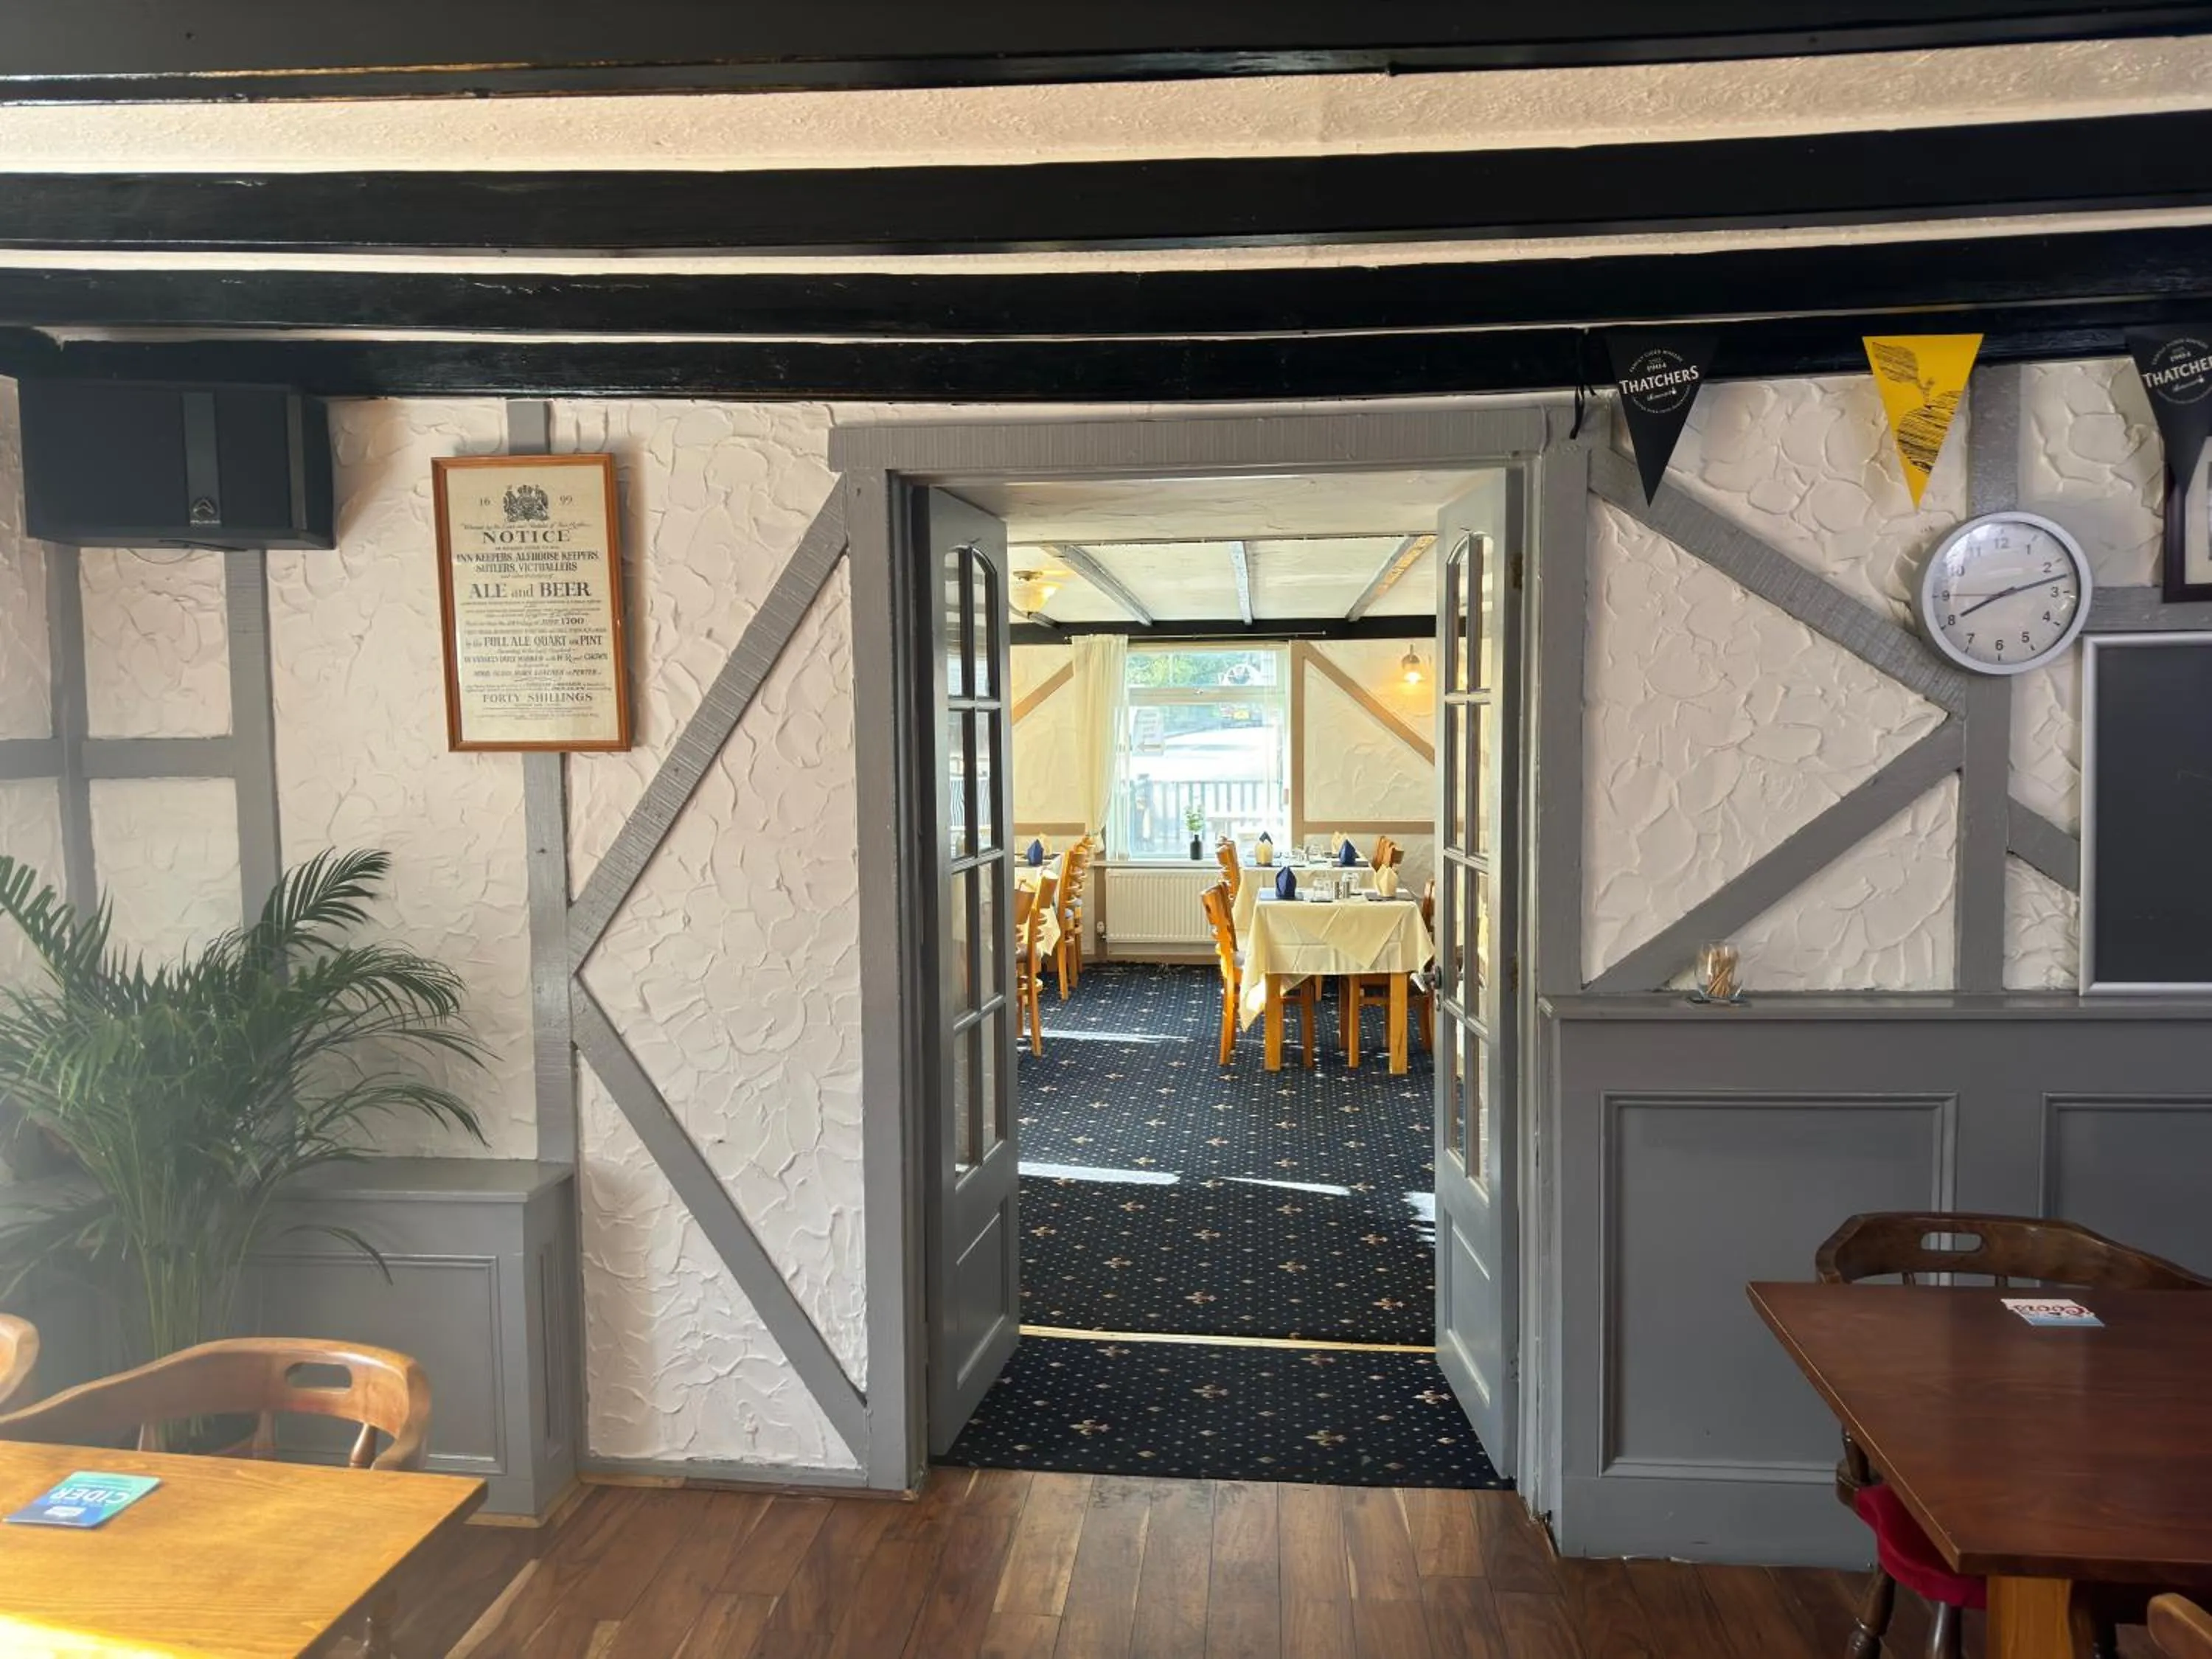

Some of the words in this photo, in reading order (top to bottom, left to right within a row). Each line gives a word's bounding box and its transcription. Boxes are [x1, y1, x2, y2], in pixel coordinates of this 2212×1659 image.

[1618, 365, 1699, 394] THATCHERS
[482, 529, 570, 544] NOTICE
[1993, 538, 2010, 549] 12
[2042, 561, 2053, 574] 2
[469, 583, 507, 599] ALE
[510, 583, 534, 598] and
[539, 581, 591, 597] BEER
[1941, 590, 1950, 601] 9
[2050, 586, 2059, 598] 3
[1947, 614, 1956, 626] 8
[2042, 611, 2051, 622] 4
[510, 636, 532, 647] ALE
[533, 635, 566, 647] QUART
[580, 634, 602, 646] PINT
[1966, 632, 1975, 644] 7
[2020, 631, 2030, 644] 5
[1994, 639, 2004, 651] 6
[483, 693, 520, 703] FORTY
[526, 692, 593, 703] SHILLINGS
[49, 1487, 131, 1503] CIDER
